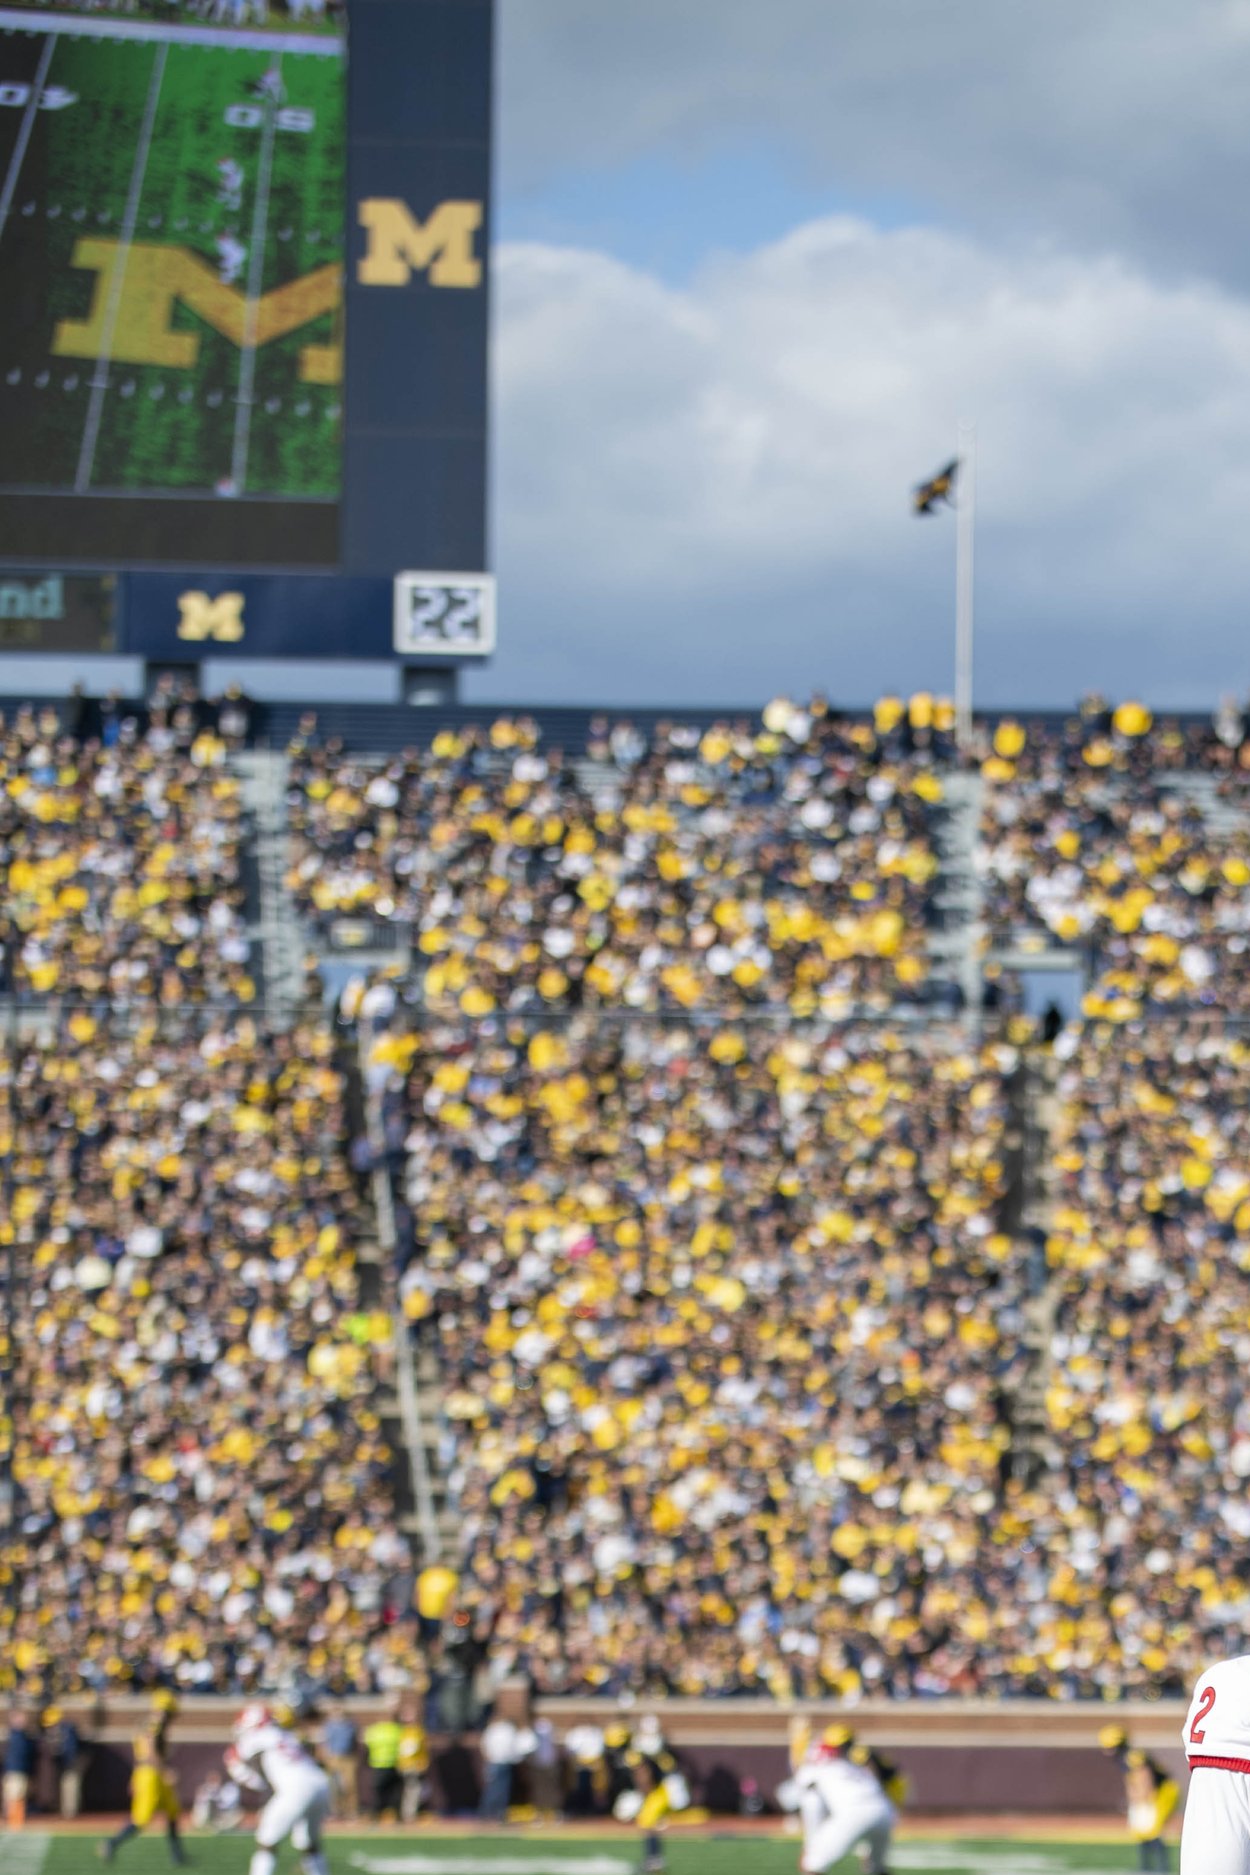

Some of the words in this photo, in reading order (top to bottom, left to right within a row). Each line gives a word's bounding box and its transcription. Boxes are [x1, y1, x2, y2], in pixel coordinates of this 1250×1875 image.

[358, 197, 481, 288] M
[178, 591, 245, 642] M
[1190, 1686, 1216, 1744] 2
